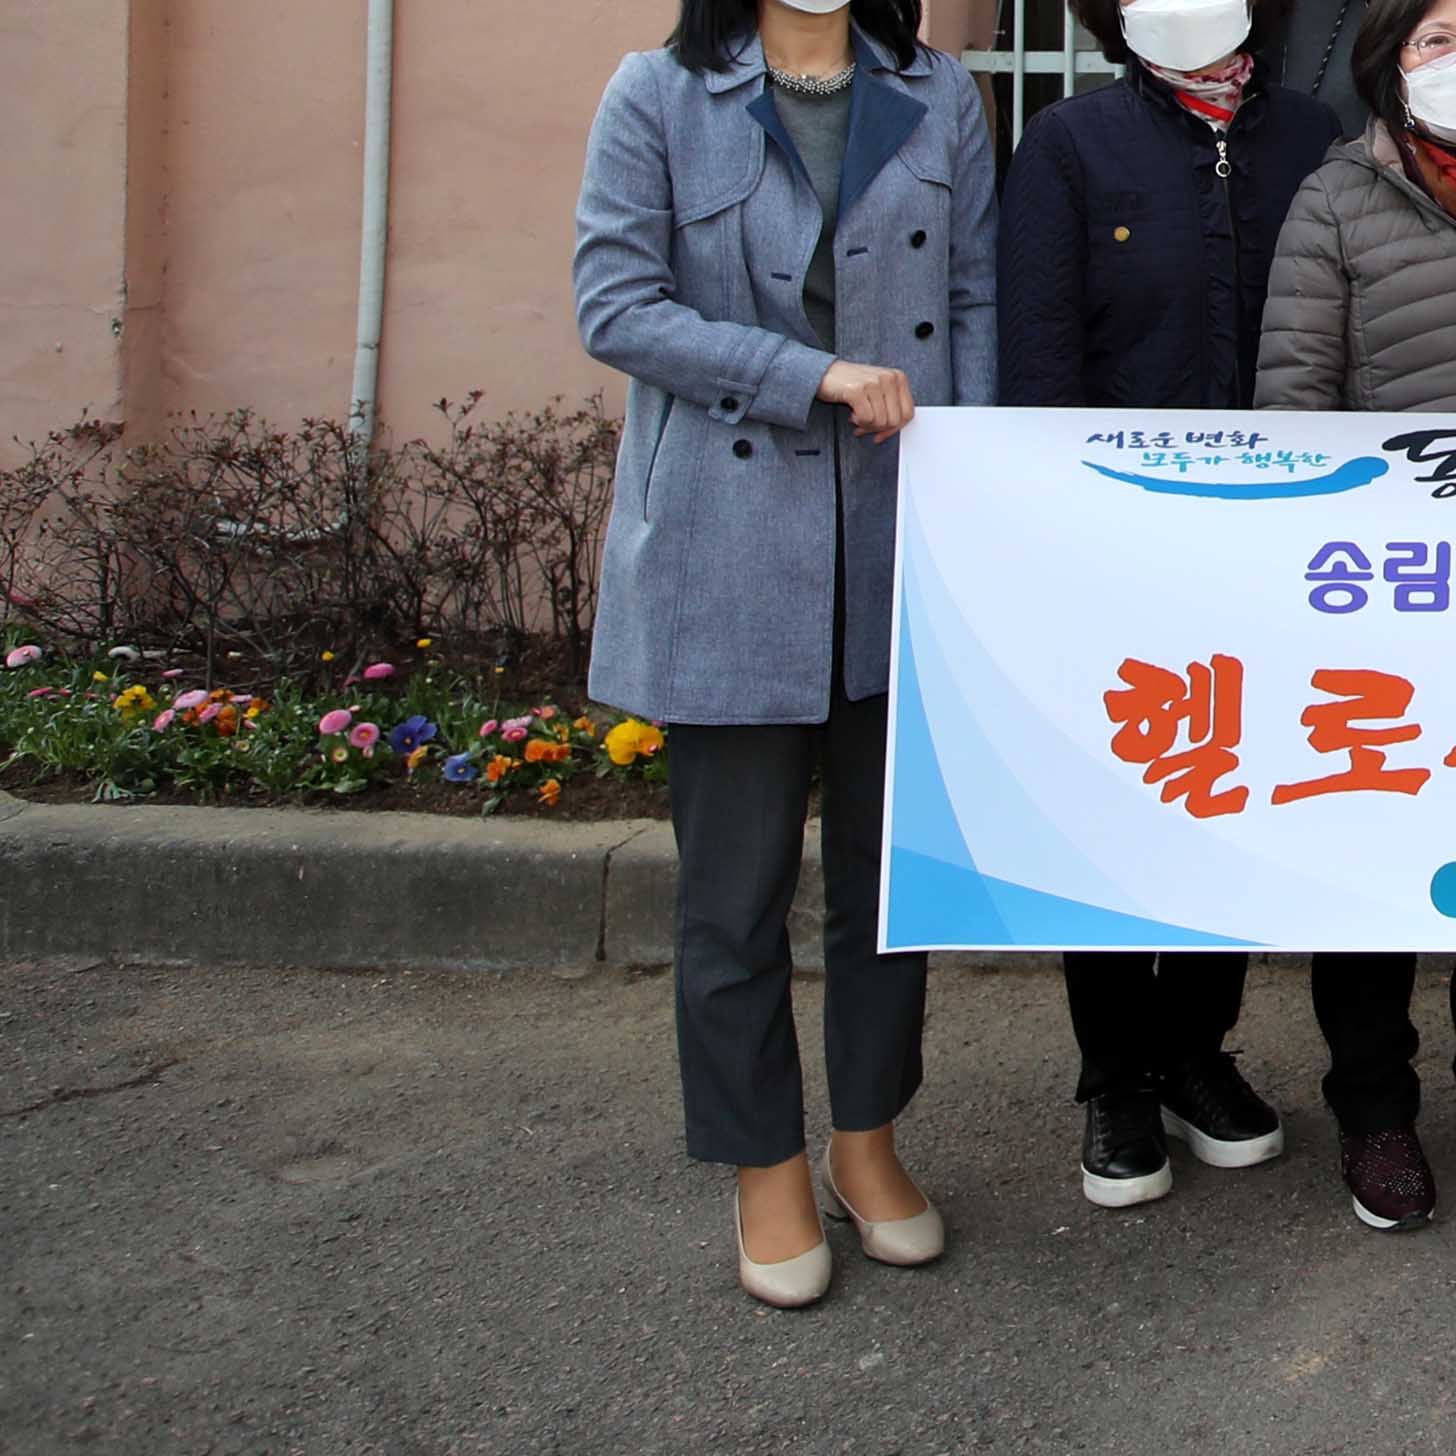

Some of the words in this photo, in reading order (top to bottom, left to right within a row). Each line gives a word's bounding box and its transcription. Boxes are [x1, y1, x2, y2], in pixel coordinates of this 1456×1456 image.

[1085, 430, 1179, 449] 새로운
[1185, 430, 1269, 450] 변화
[1141, 451, 1230, 473] 모두가
[1235, 450, 1331, 473] 행복한
